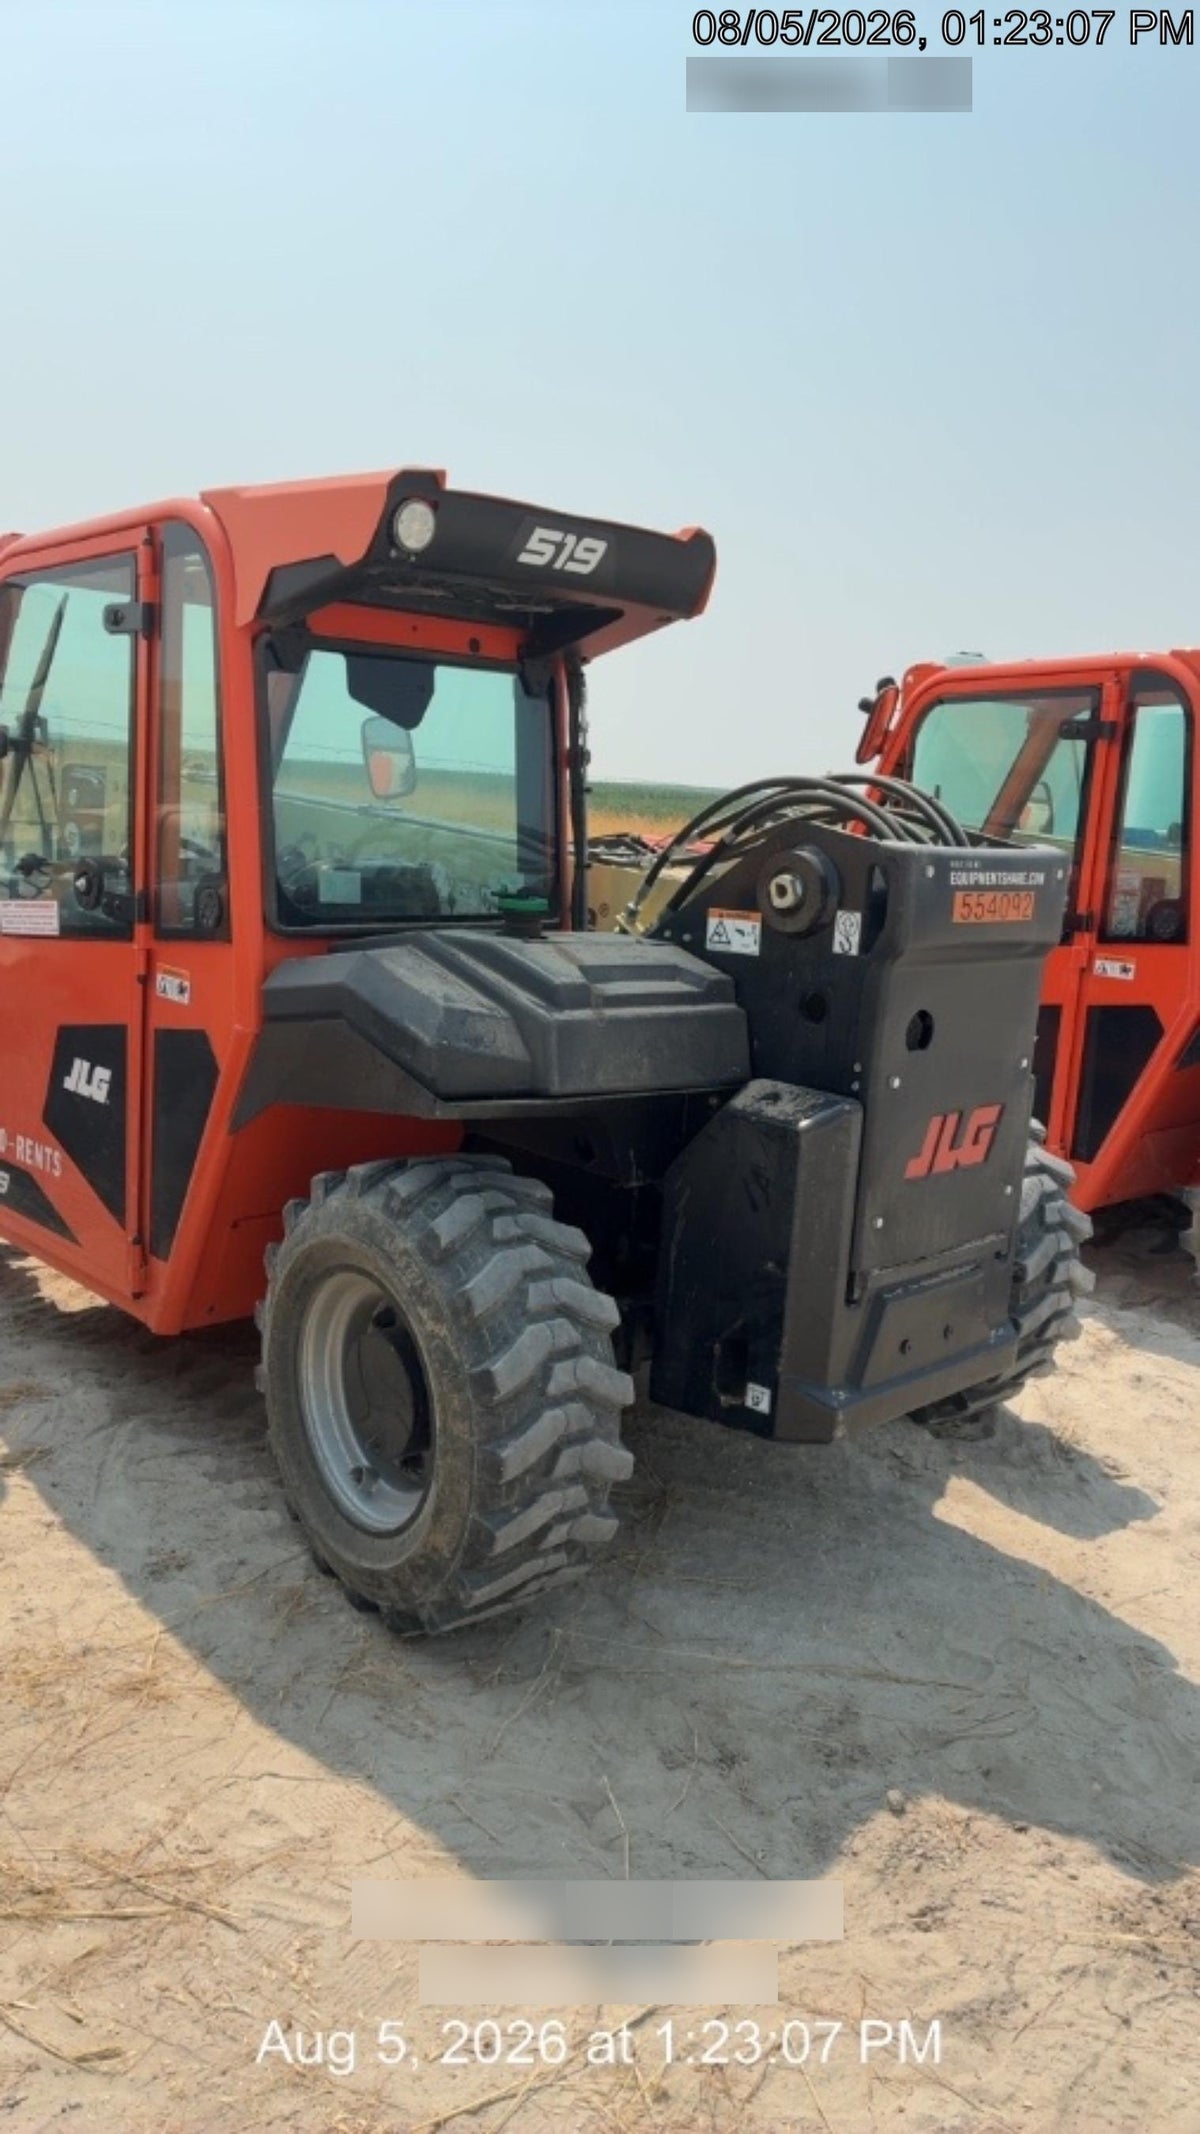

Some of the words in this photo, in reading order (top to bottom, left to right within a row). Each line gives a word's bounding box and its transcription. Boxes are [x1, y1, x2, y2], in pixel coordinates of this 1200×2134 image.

[517, 526, 608, 574] 519
[960, 892, 1032, 920] 554092
[63, 1056, 111, 1104] JLG
[903, 1103, 1005, 1181] JLG
